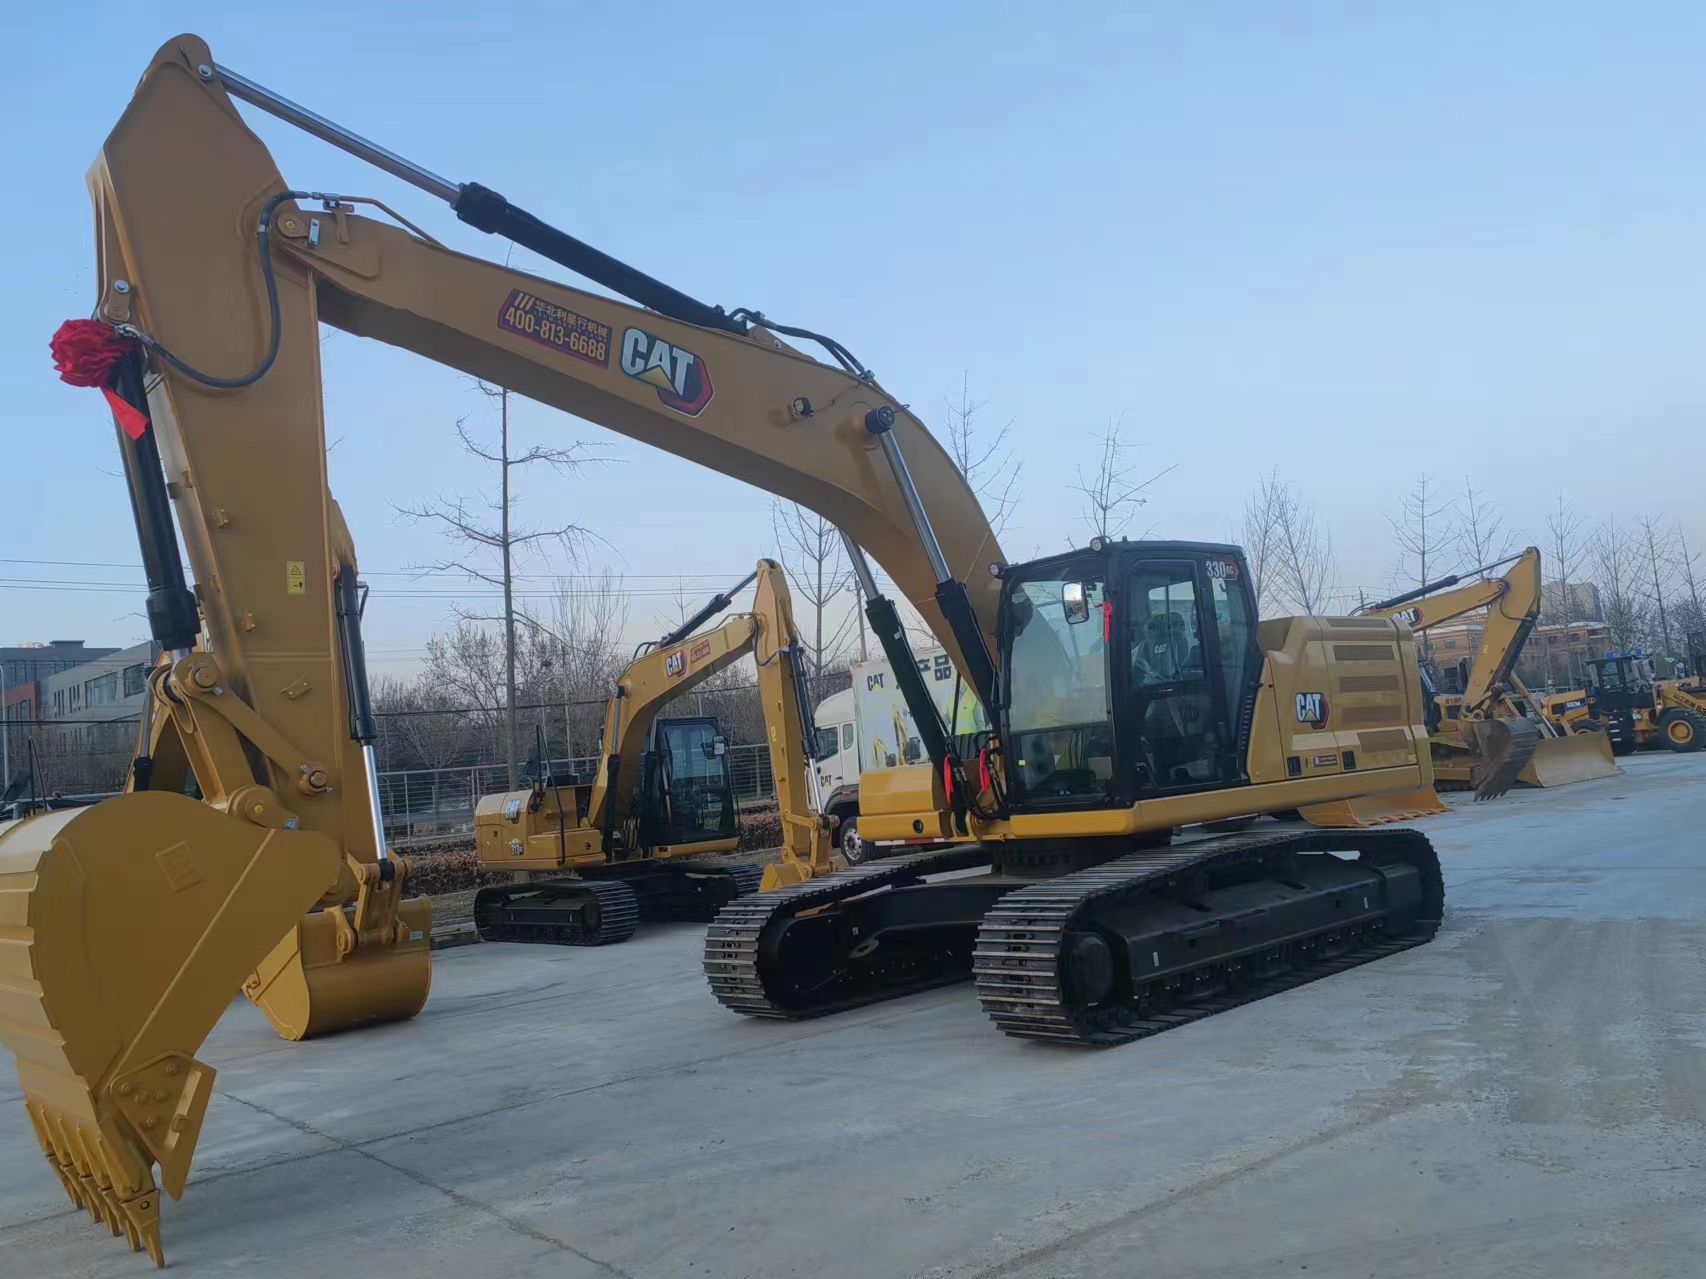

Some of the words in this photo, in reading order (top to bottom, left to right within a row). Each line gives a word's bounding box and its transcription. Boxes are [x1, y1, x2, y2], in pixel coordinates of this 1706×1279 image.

[534, 300, 609, 338] 华北利星行机械
[505, 306, 606, 361] 400-813-6688
[621, 328, 694, 397] CAT
[1205, 560, 1226, 578] 330
[1154, 643, 1167, 654] CAT
[666, 651, 682, 677] CAT
[867, 673, 884, 691] CAT
[1295, 693, 1321, 722] CAT
[820, 774, 832, 787] CAT
